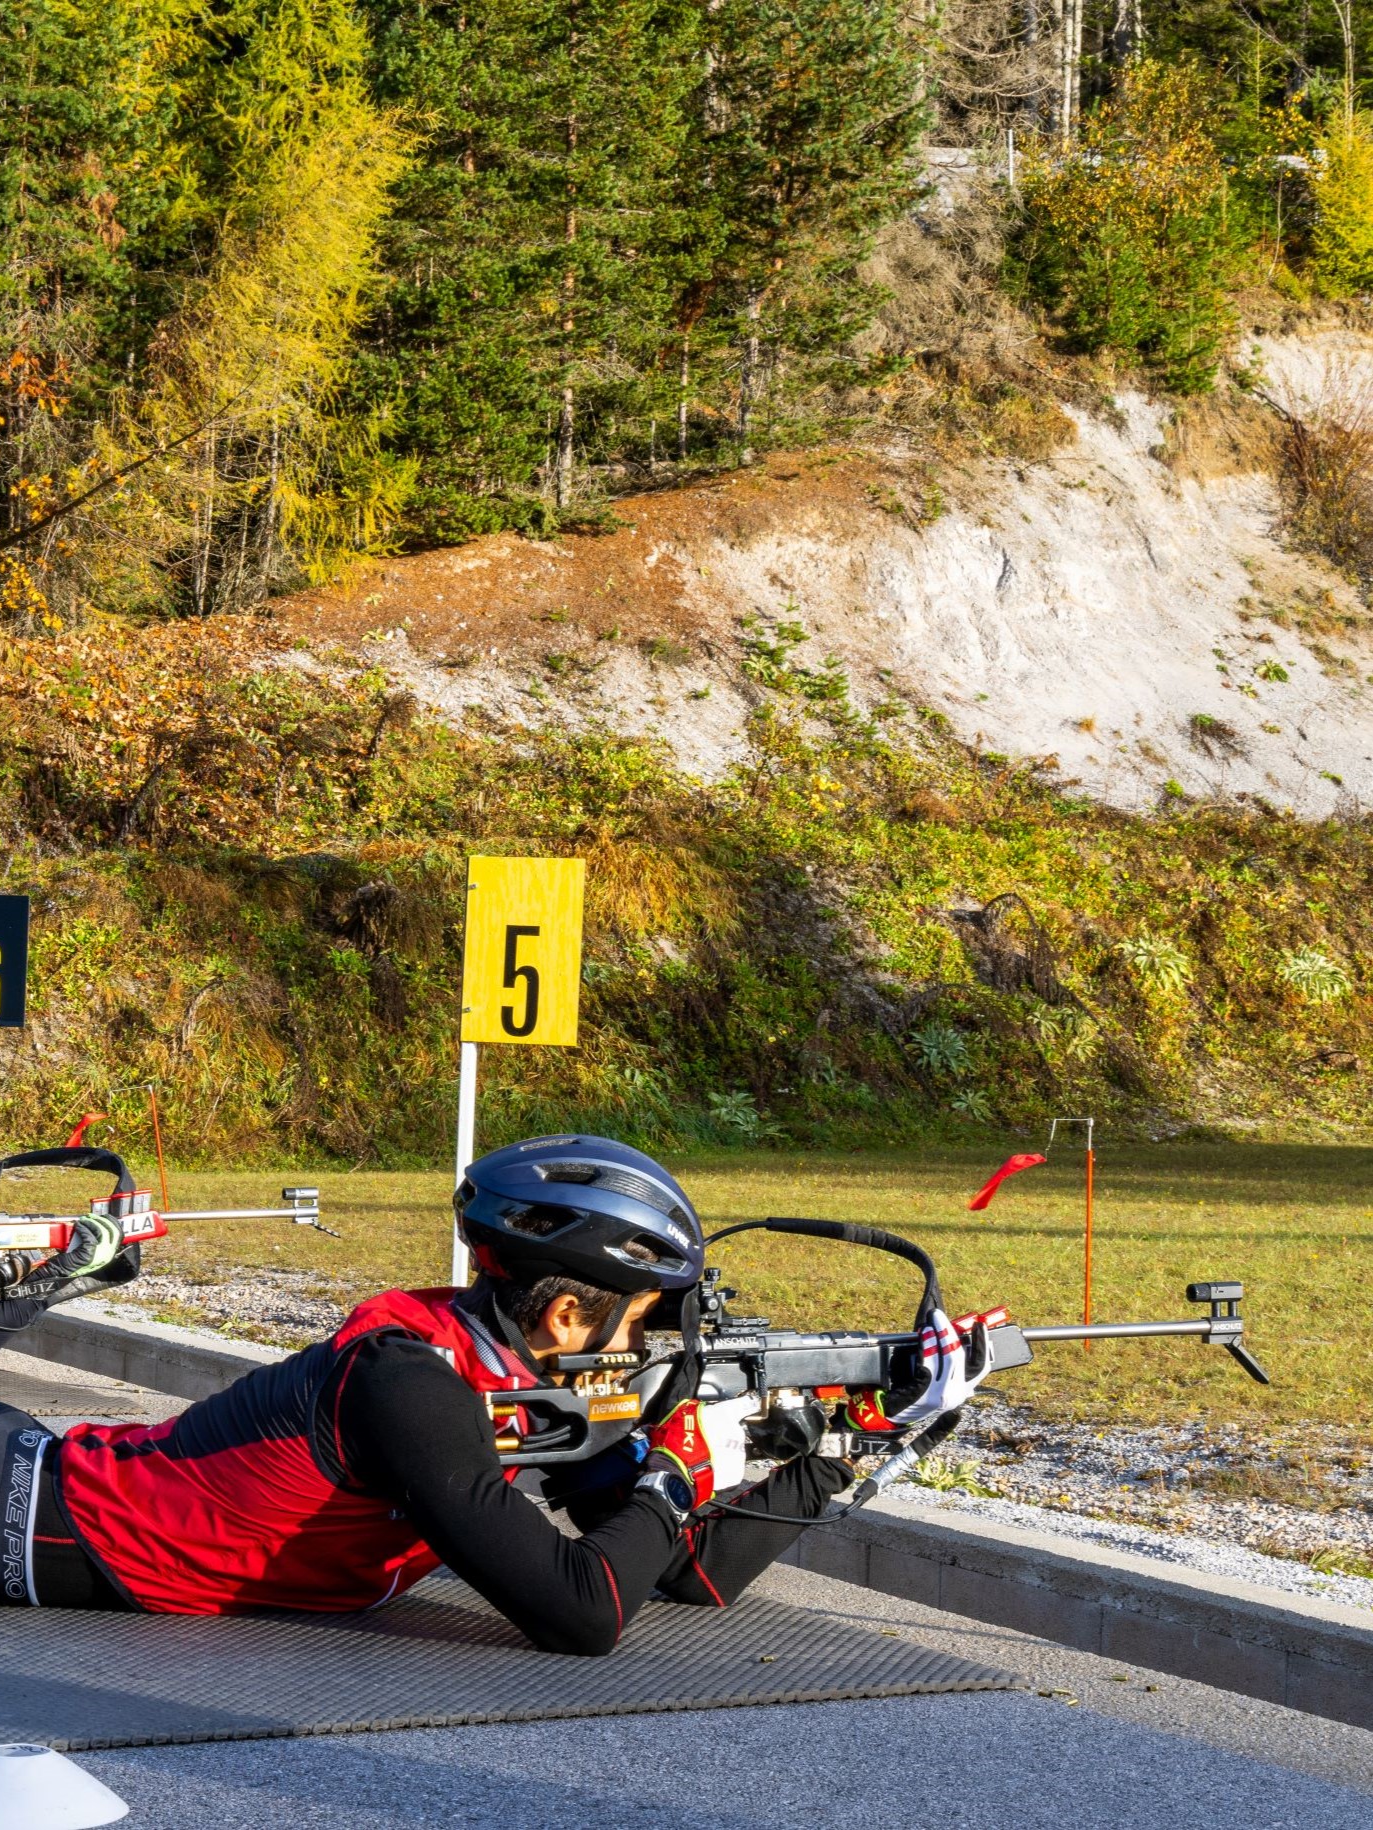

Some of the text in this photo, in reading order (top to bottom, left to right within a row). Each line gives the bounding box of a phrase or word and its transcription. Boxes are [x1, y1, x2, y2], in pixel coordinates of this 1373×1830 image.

[501, 924, 540, 1037] 5
[3, 1453, 33, 1599] NIKE PRO
